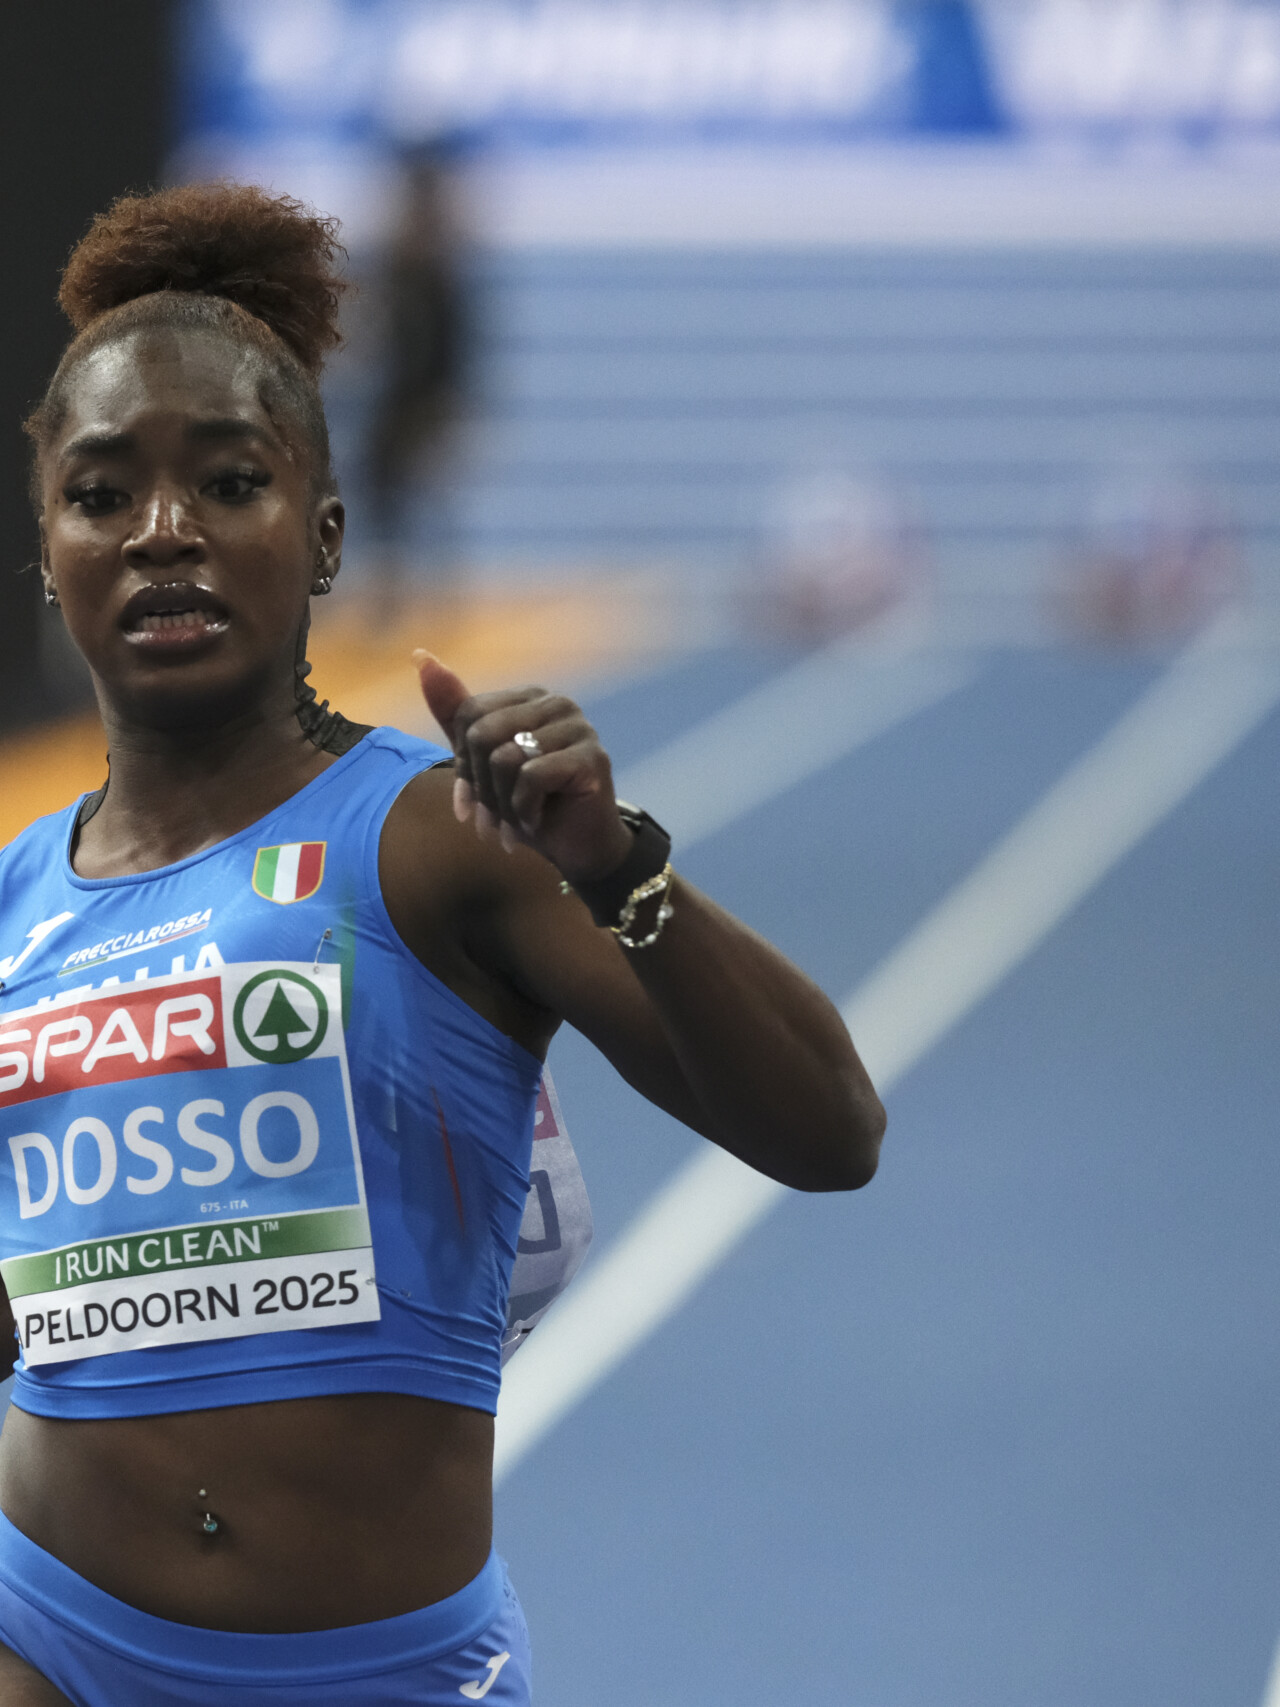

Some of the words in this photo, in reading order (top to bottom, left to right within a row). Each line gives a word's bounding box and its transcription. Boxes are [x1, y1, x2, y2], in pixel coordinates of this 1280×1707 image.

[62, 908, 213, 968] FRECCIAROSSA
[8, 1091, 320, 1220] DOSSO
[200, 1202, 221, 1213] 675
[230, 1199, 249, 1210] ITA
[55, 1256, 61, 1285] I
[66, 1243, 129, 1282] RUN
[15, 1283, 240, 1350] PELDOORN
[254, 1270, 360, 1315] 2025
